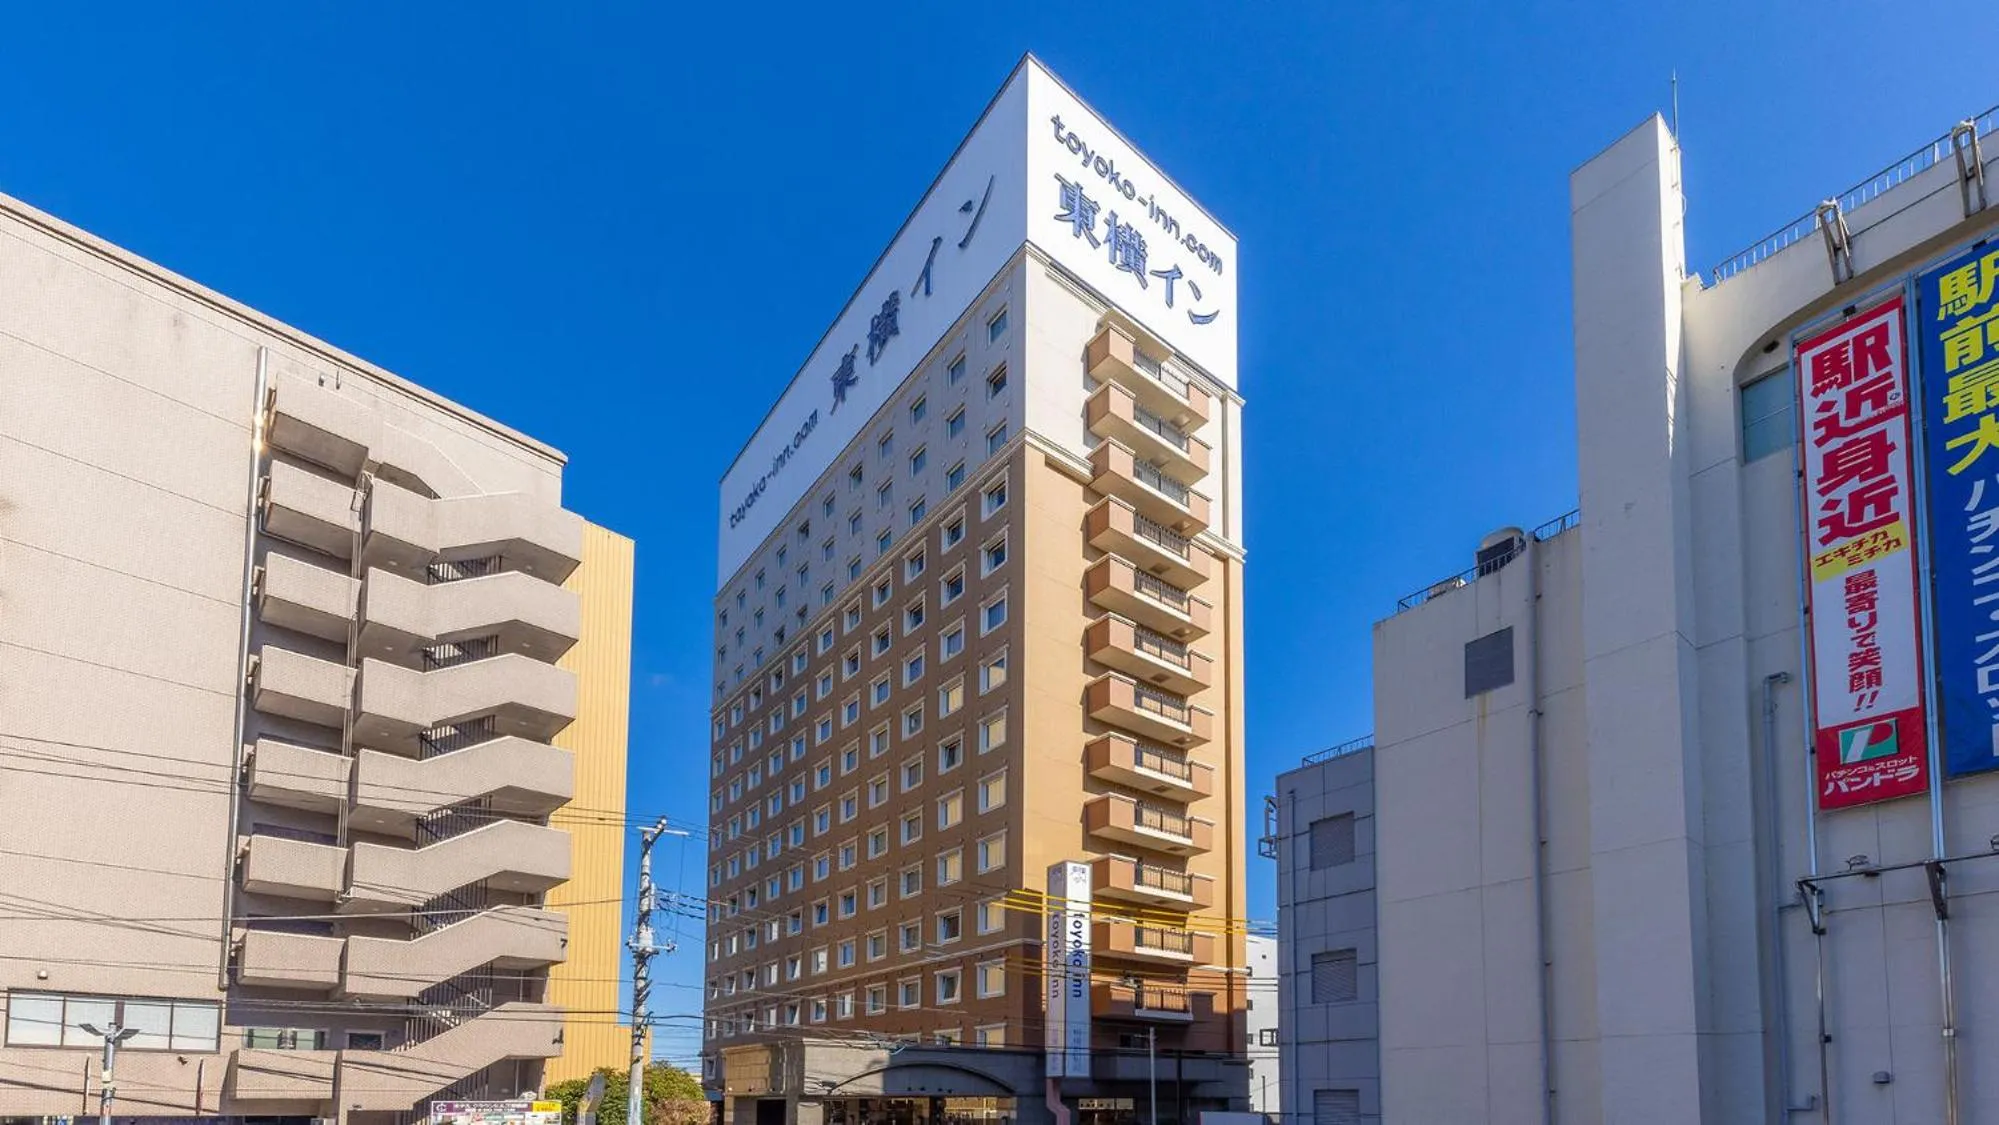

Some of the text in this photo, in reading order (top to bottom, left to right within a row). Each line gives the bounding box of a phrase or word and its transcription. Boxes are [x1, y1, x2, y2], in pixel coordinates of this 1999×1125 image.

[1050, 114, 1223, 276] toyoko-inn.com
[1053, 172, 1220, 325] 東横イン
[830, 174, 995, 417] 東横イン
[729, 408, 818, 530] toyoko-inn.com
[1811, 321, 1900, 547] 駅近身近
[1815, 529, 1889, 567] エキチカ
[1070, 913, 1086, 998] toyoko inn
